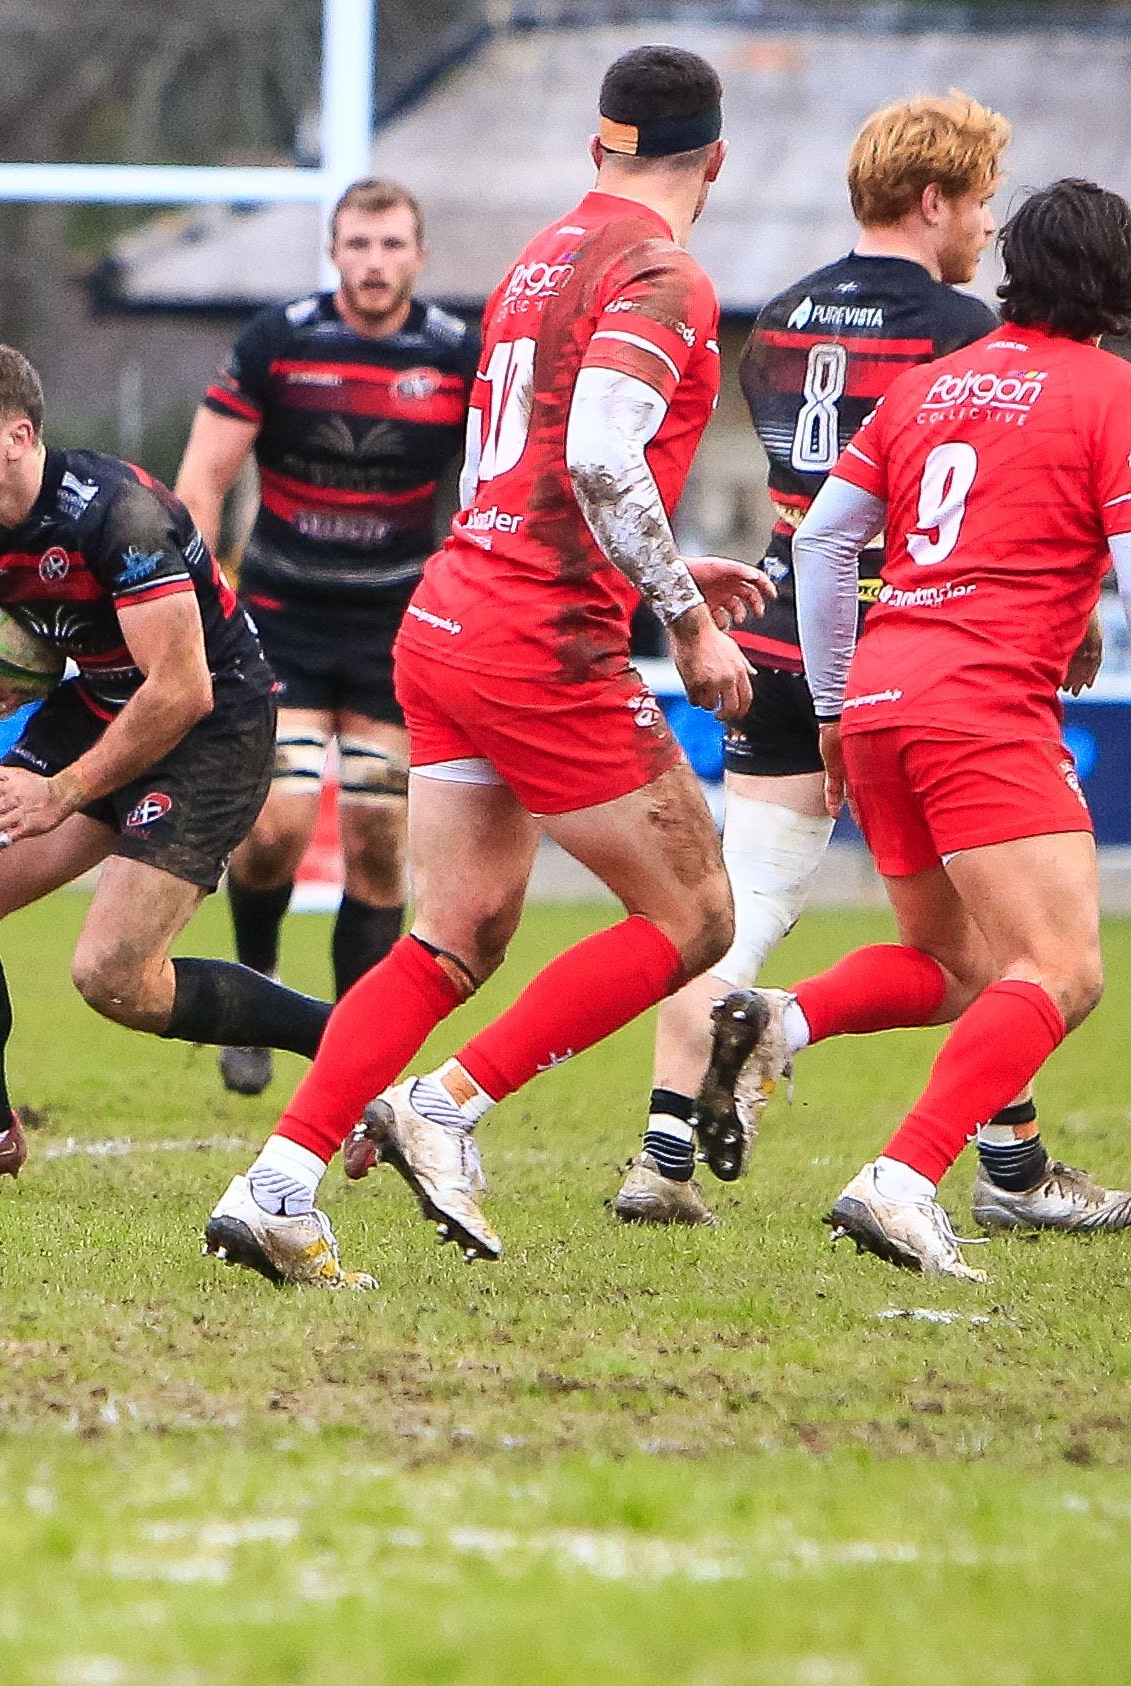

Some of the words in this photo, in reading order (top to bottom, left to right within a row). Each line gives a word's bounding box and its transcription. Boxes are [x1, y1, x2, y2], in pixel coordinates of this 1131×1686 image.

[791, 342, 847, 473] 8
[917, 407, 1028, 426] COLLECTIVE
[925, 369, 1043, 405] Polygon
[906, 441, 978, 565] 9
